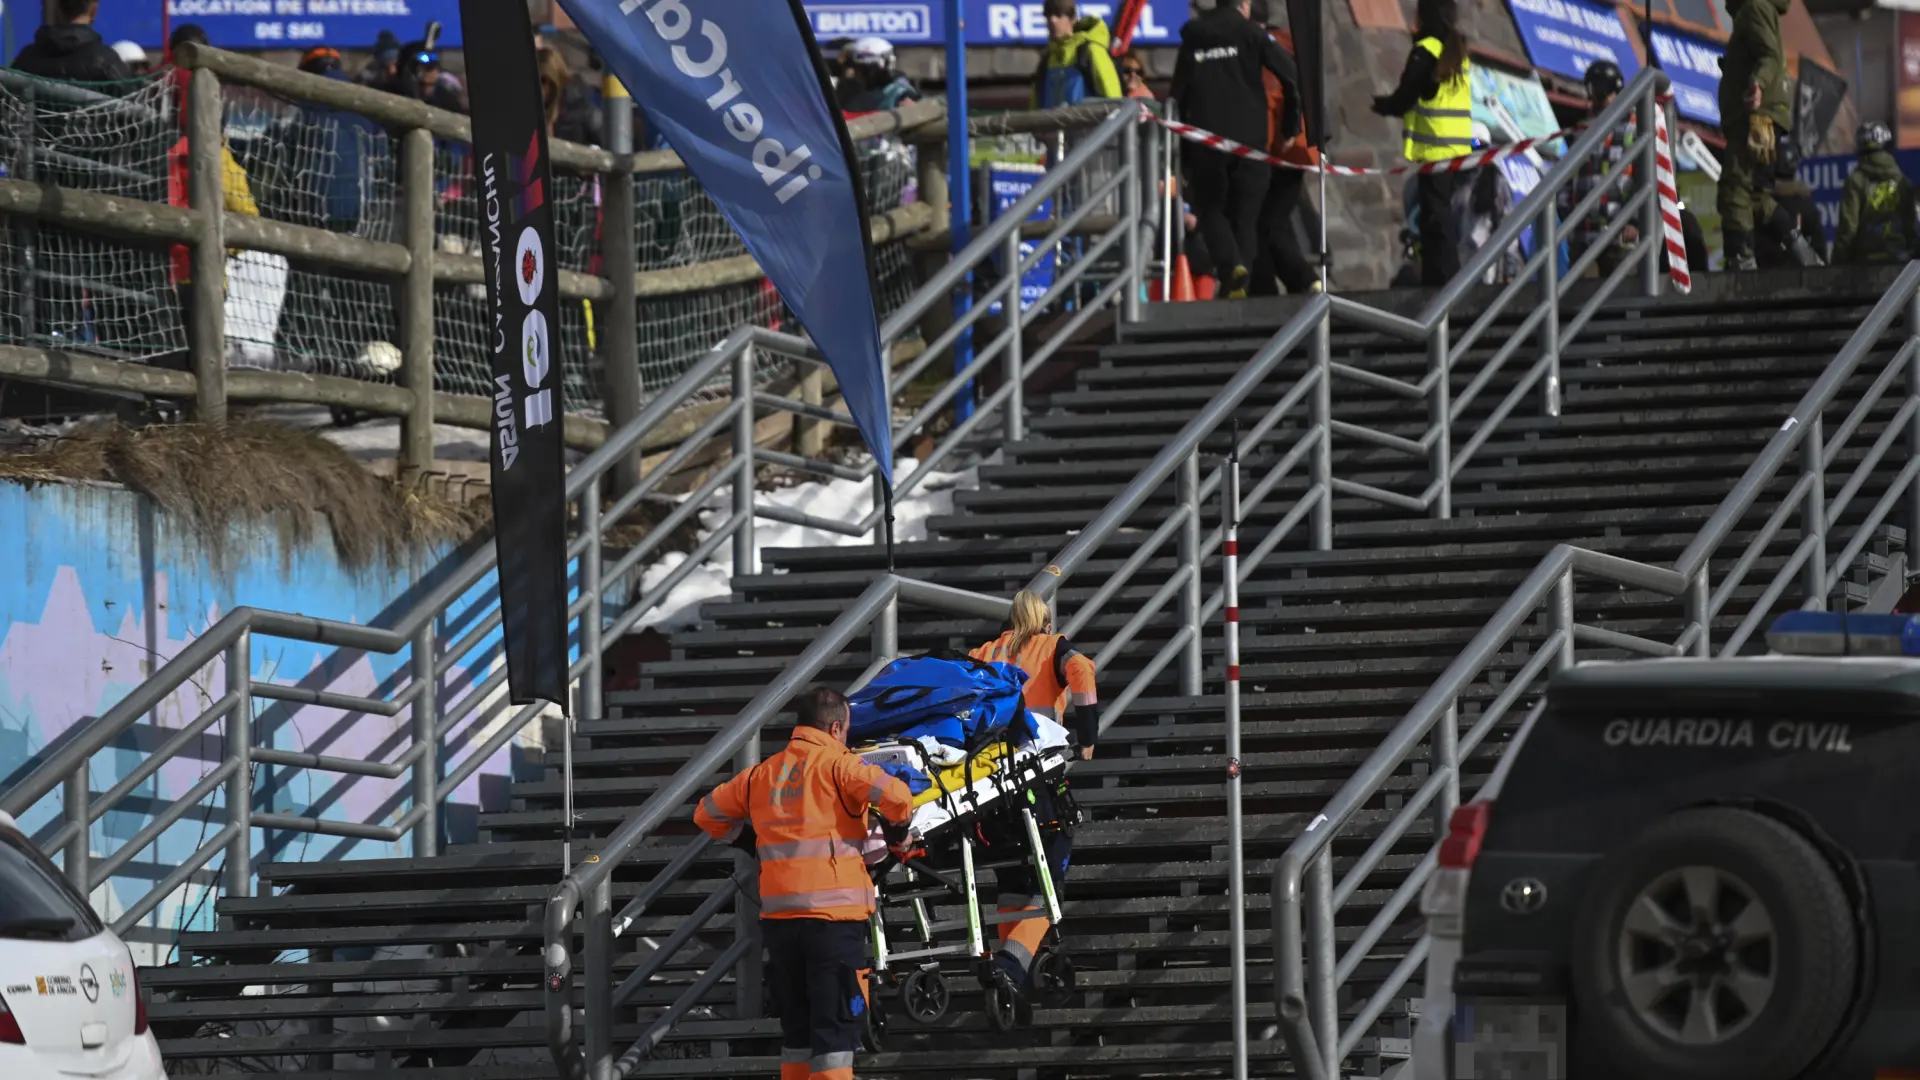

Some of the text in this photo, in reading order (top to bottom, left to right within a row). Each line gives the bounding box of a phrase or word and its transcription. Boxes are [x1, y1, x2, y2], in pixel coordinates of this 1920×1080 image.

[275, 0, 304, 15] DE
[254, 22, 325, 39] DE SKI
[817, 12, 919, 33] BURTON
[1603, 717, 1852, 752] GUARDIA CIVIL
